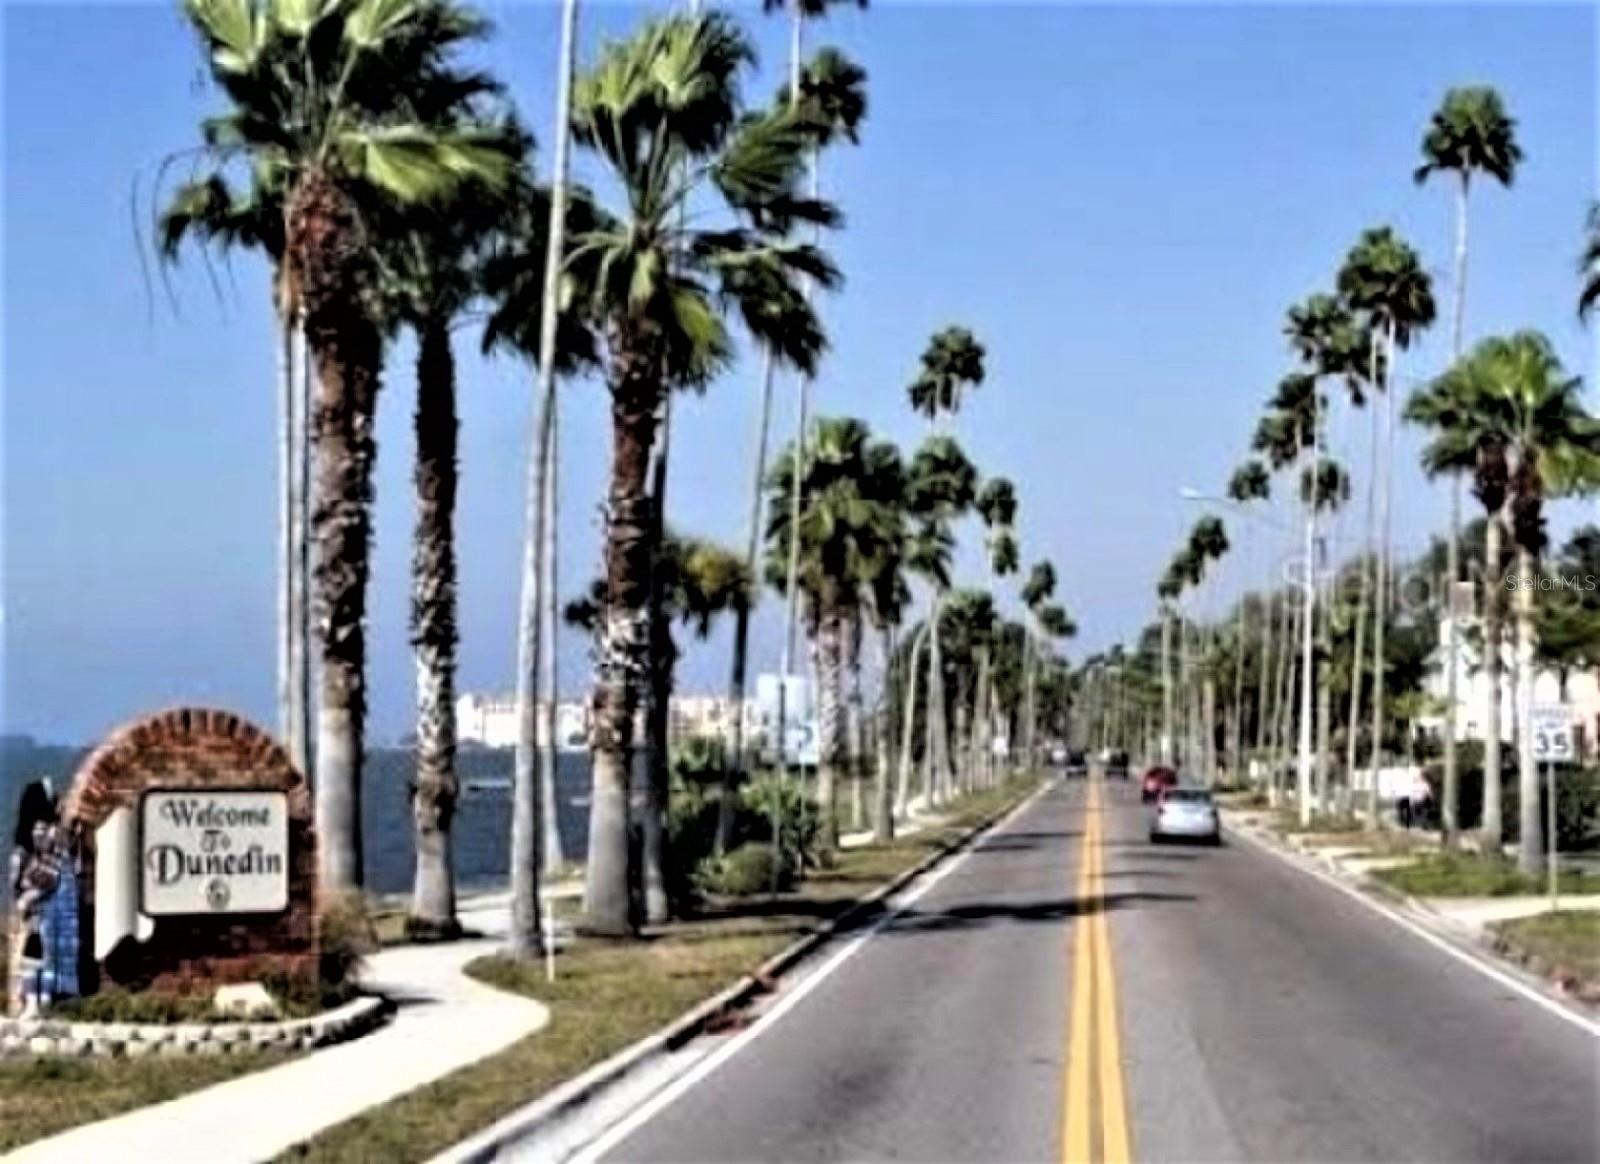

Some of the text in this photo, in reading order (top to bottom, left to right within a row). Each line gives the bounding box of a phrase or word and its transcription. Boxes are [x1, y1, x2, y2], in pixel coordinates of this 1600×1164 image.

[1535, 733, 1568, 753] 35
[160, 799, 270, 827] Welcome
[201, 829, 230, 852] To
[148, 844, 282, 885] Dunedin
